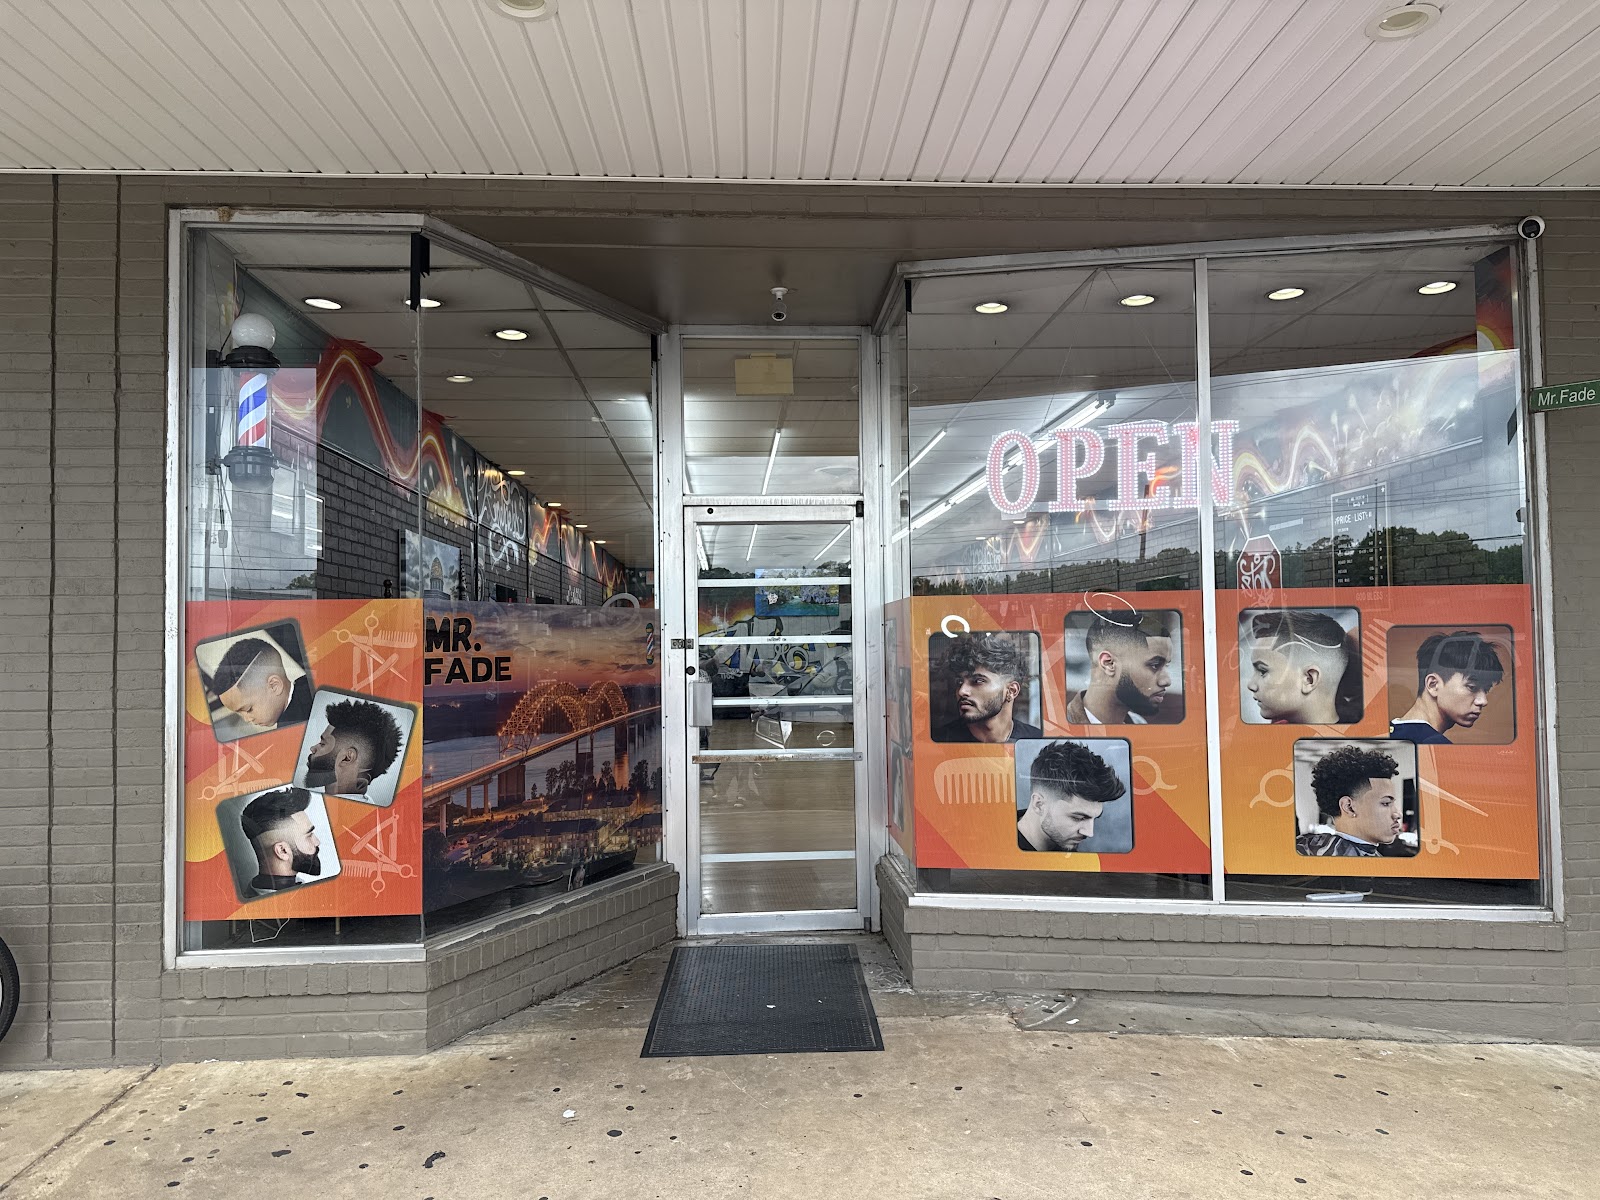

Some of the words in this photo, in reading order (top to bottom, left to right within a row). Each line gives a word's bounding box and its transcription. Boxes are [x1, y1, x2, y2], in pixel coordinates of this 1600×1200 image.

[1537, 386, 1596, 407] Mr.Fade
[985, 420, 1239, 514] OPEN
[1336, 514, 1352, 525] PRICE
[424, 616, 482, 653] MR.
[424, 656, 512, 686] FADE
